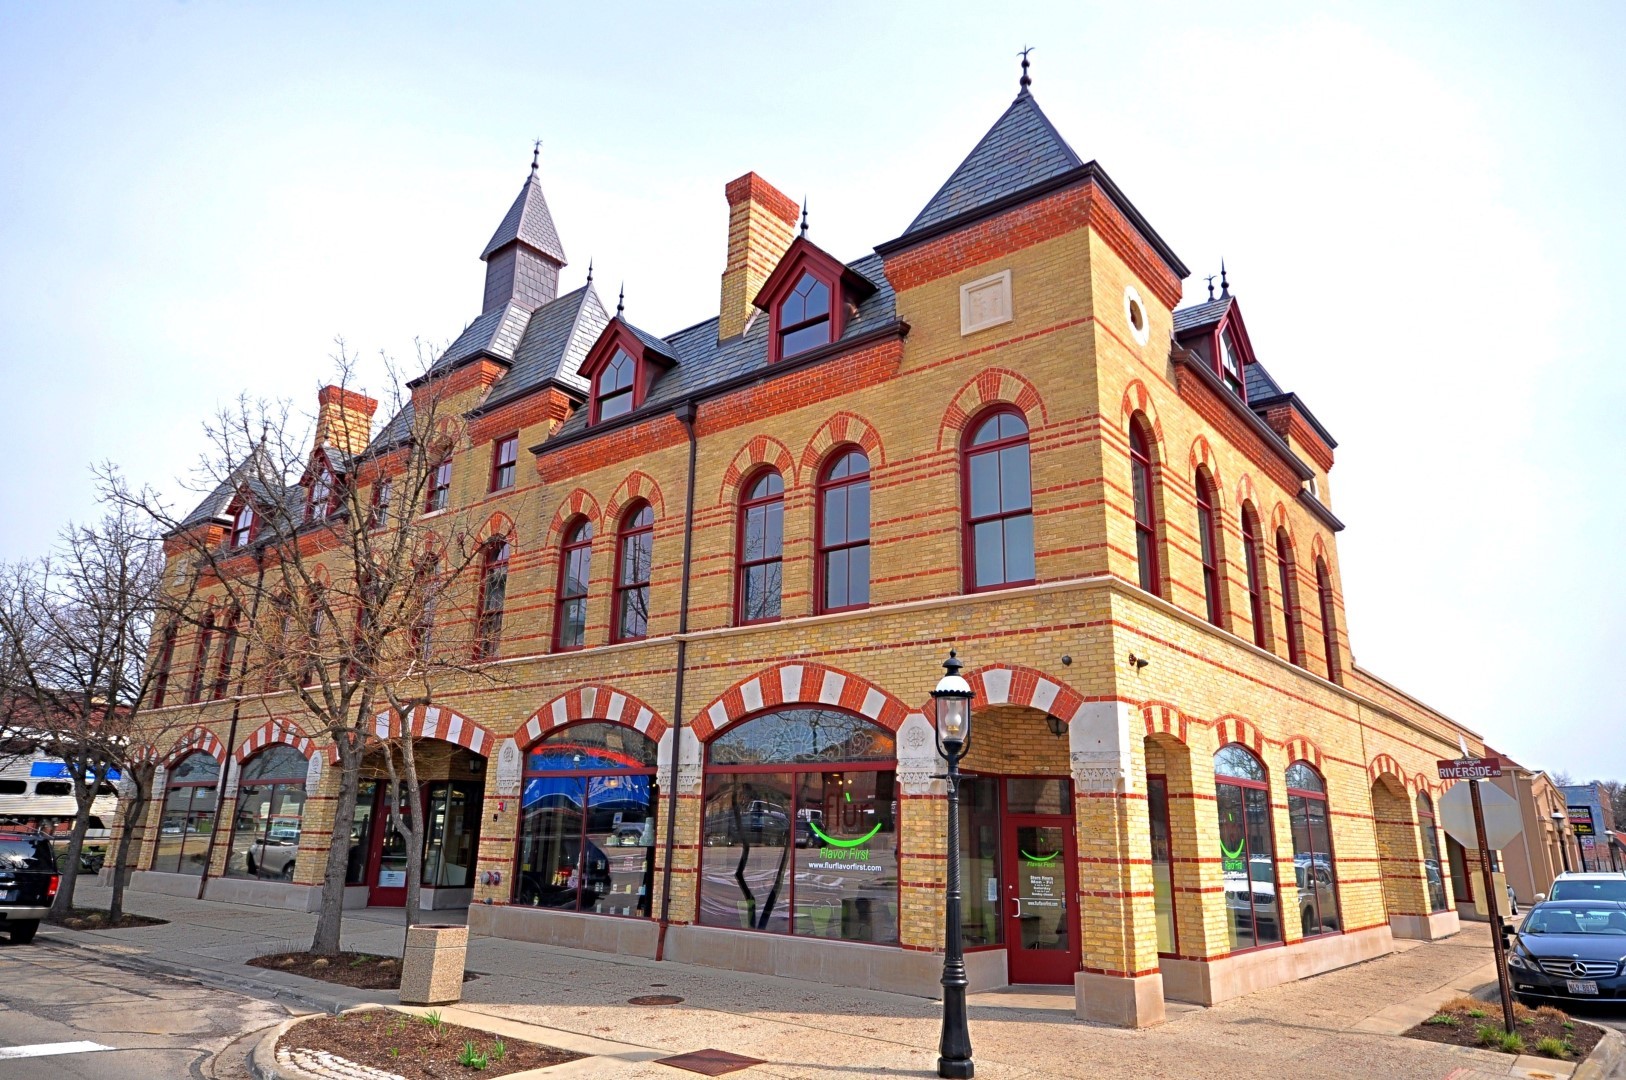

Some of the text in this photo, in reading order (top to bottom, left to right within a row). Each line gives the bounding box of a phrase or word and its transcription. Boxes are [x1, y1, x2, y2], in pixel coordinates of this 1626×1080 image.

[1439, 766, 1492, 777] RIVERSIDE
[820, 847, 870, 861] Flavor First
[808, 861, 882, 872] www.flurflavorfirst.com
